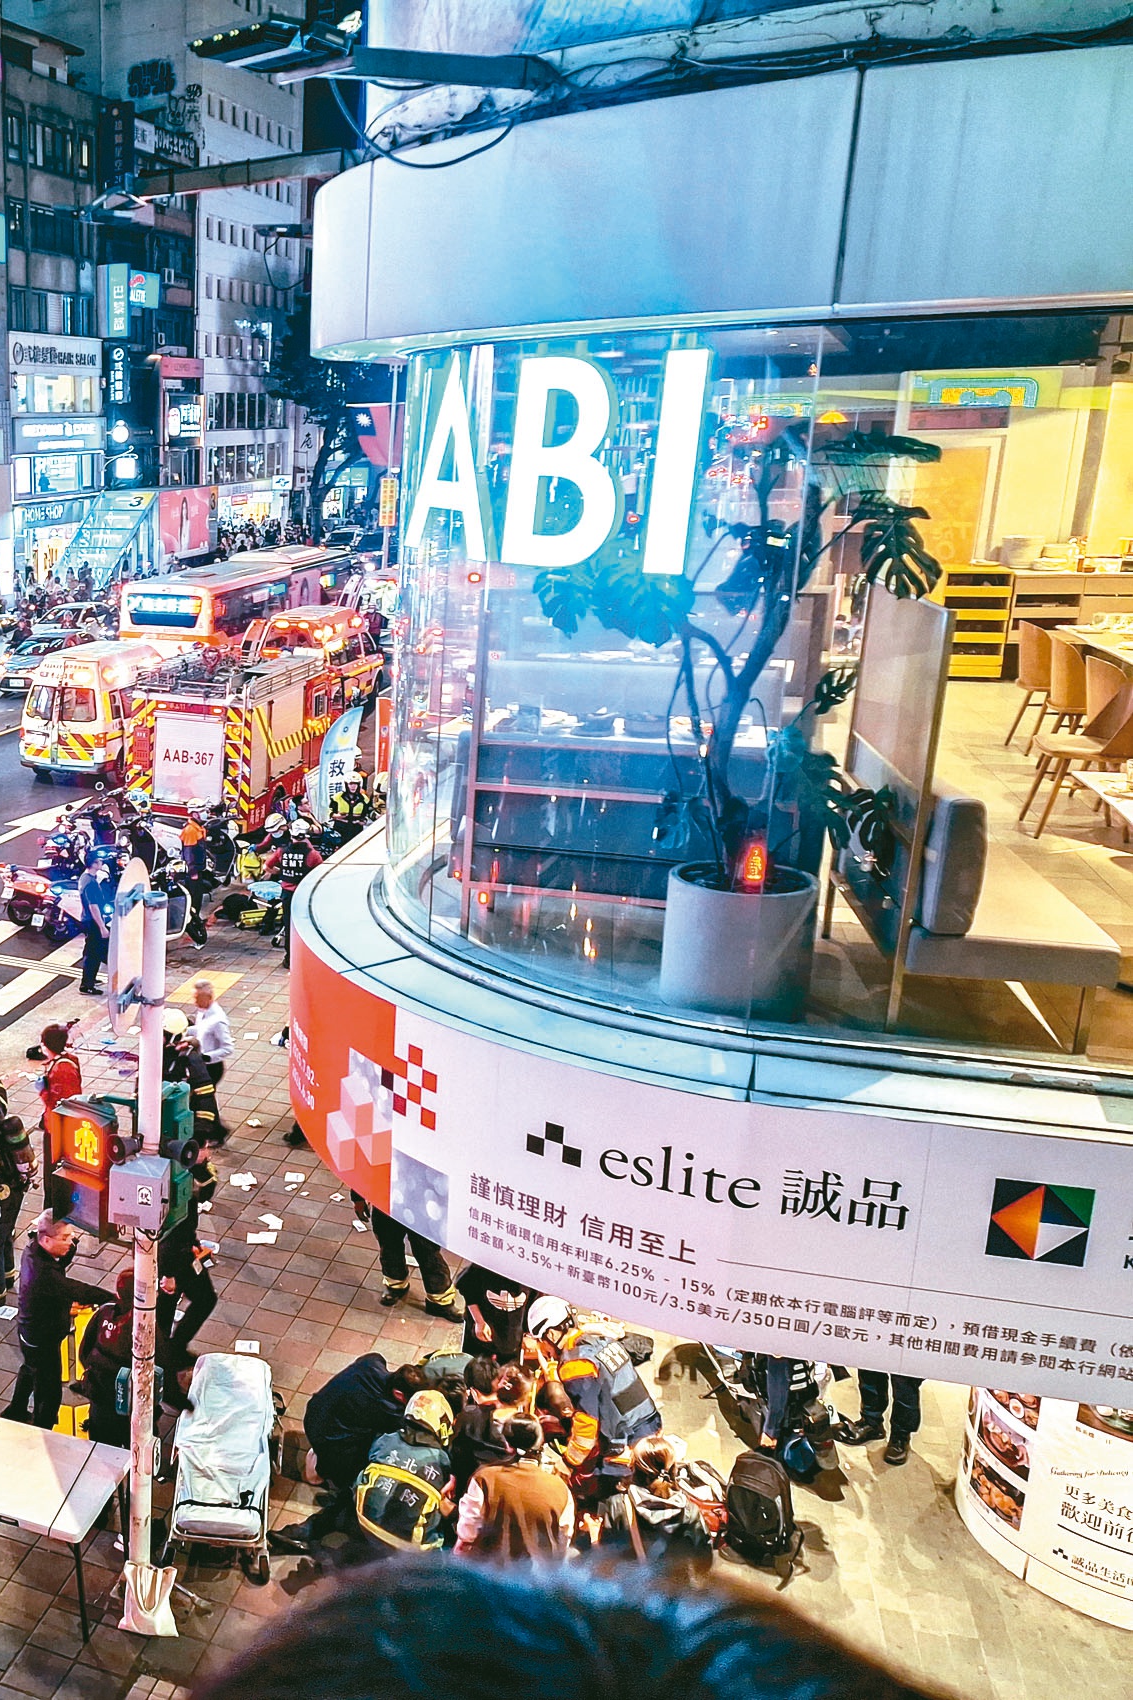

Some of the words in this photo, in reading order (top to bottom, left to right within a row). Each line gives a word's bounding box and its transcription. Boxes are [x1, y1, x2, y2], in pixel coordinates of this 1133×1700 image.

[404, 346, 710, 575] ABI
[26, 507, 45, 522] HOME
[45, 504, 65, 520] SHOP
[162, 748, 215, 767] AAB-367
[282, 859, 304, 867] EMT
[598, 1146, 762, 1209] eslite
[780, 1167, 911, 1232] 誠品
[469, 1172, 569, 1229] 謹慎理財
[579, 1212, 697, 1266] 信用至上
[377, 1476, 420, 1508] 消防
